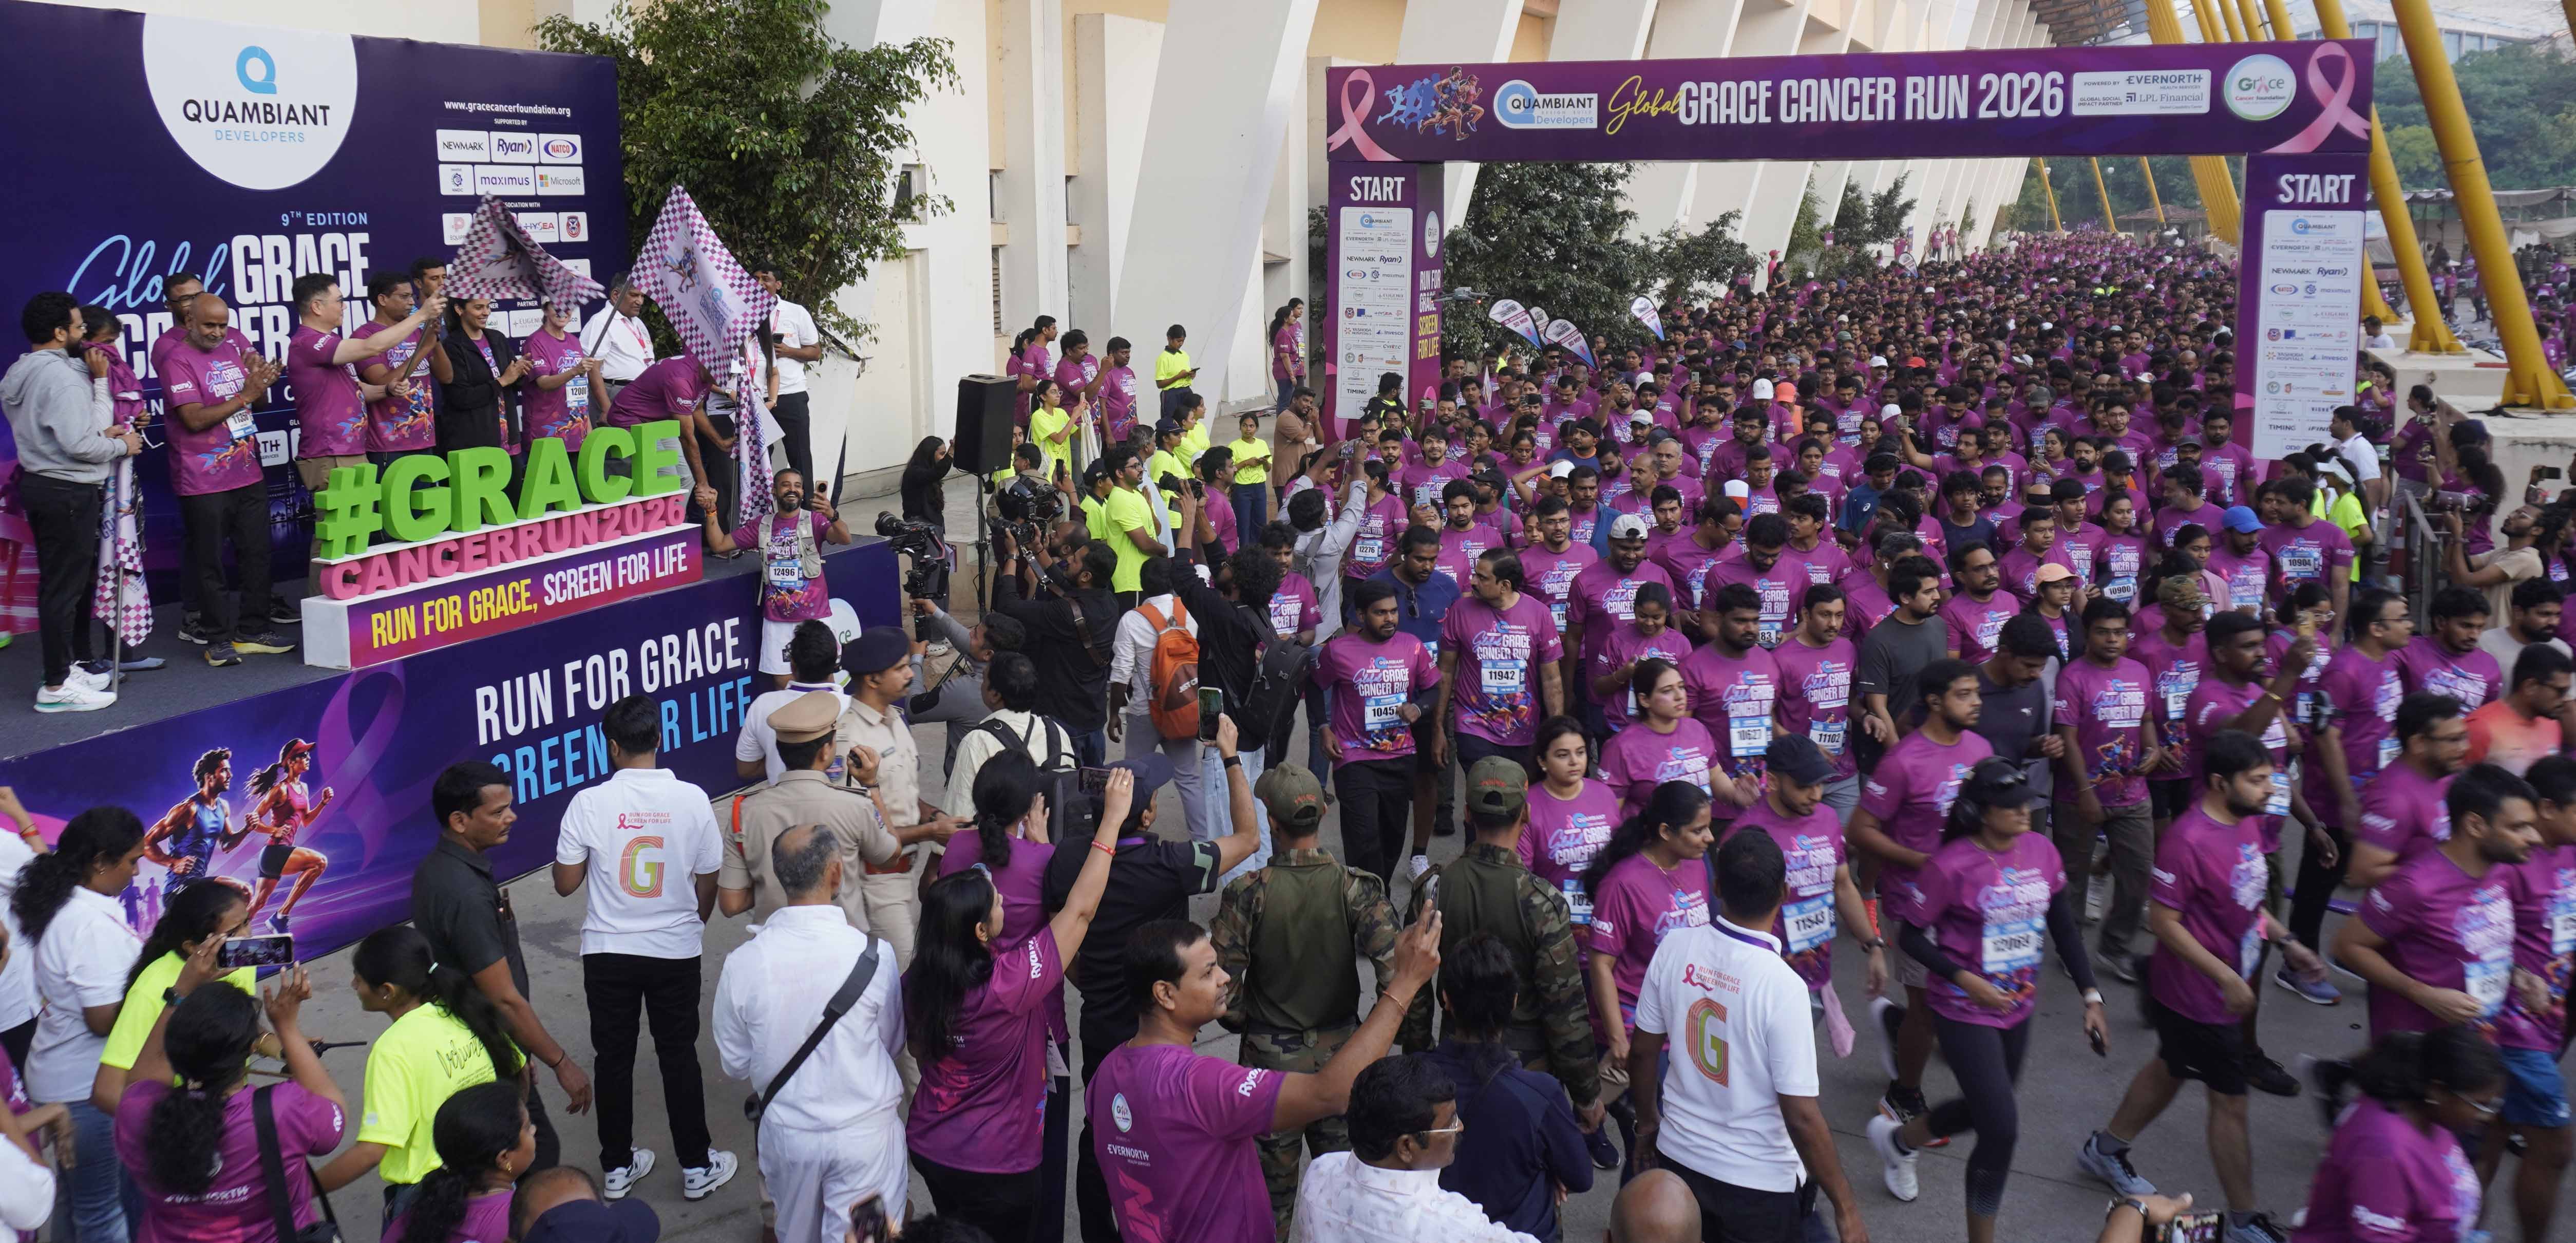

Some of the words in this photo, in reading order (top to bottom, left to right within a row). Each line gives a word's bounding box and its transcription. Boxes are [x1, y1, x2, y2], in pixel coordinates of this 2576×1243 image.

[2126, 74, 2203, 85] EVERNORTH
[1511, 97, 1594, 110] QUAMBIANT
[1606, 75, 1685, 135] Global
[1679, 80, 1772, 125] GRACE
[1780, 77, 1896, 123] CANCER
[1905, 74, 1968, 120] RUN
[1979, 71, 2064, 119] 2026
[2139, 94, 2157, 102] LPL
[2160, 92, 2203, 102] Financial
[183, 99, 329, 126] QUAMBIANT
[444, 101, 571, 117] www.gracecancerfoundation.org
[1537, 115, 1594, 126] Developers
[215, 129, 305, 143] DEVELOPERS
[443, 141, 484, 150] NEWMARK
[497, 138, 524, 156] Ryan
[551, 145, 570, 154] NATCO
[480, 176, 530, 186] maximus
[551, 176, 581, 185] Microsoft
[1350, 176, 1405, 201] START
[2279, 174, 2356, 203] START
[307, 212, 368, 226] EDITION
[231, 233, 369, 305] GRACE
[2317, 267, 2340, 276] Ryan
[1420, 271, 1430, 290] RUN
[1432, 269, 1441, 289] FOR
[1419, 314, 1438, 336] SCREEN
[1418, 338, 1428, 360] FOR
[1429, 336, 1439, 357] LIFE
[315, 420, 681, 560] #GRACE
[1758, 503, 1777, 513] GRACE
[320, 494, 686, 600] CANCERRUN2026
[2072, 550, 2091, 560] GRACE
[372, 605, 415, 648] RUN
[423, 595, 463, 636] FOR
[469, 578, 538, 624] GRACE,
[543, 559, 613, 605] SCREEN
[618, 551, 650, 588] FOR
[654, 542, 688, 578] LIFE
[1765, 590, 1789, 601] GRACE
[2109, 586, 2131, 594] 10900
[1607, 601, 1635, 613] CANCE
[1774, 602, 1789, 613] RUN
[1502, 635, 1530, 647] GRACE
[1477, 647, 1510, 660] CANCER
[1513, 647, 1530, 660] RUN
[476, 669, 553, 745] RUN
[564, 648, 629, 718] FOR
[641, 617, 749, 693] GRACE,
[1382, 669, 1409, 683] GRACE
[1489, 671, 1515, 681] 11942
[1358, 682, 1392, 696] CANCER
[1808, 687, 1837, 702] CANCER
[691, 676, 752, 742] LIFE
[619, 836, 664, 898] G
[1699, 965, 1713, 976] RUN
[1714, 970, 1722, 980] FOR
[1722, 973, 1740, 986] GRACE
[1696, 973, 1719, 987] SCREEN
[1728, 985, 1740, 994] LIFE
[1685, 997, 1729, 1087] G
[1107, 1144, 1149, 1161] EVERNORTH
